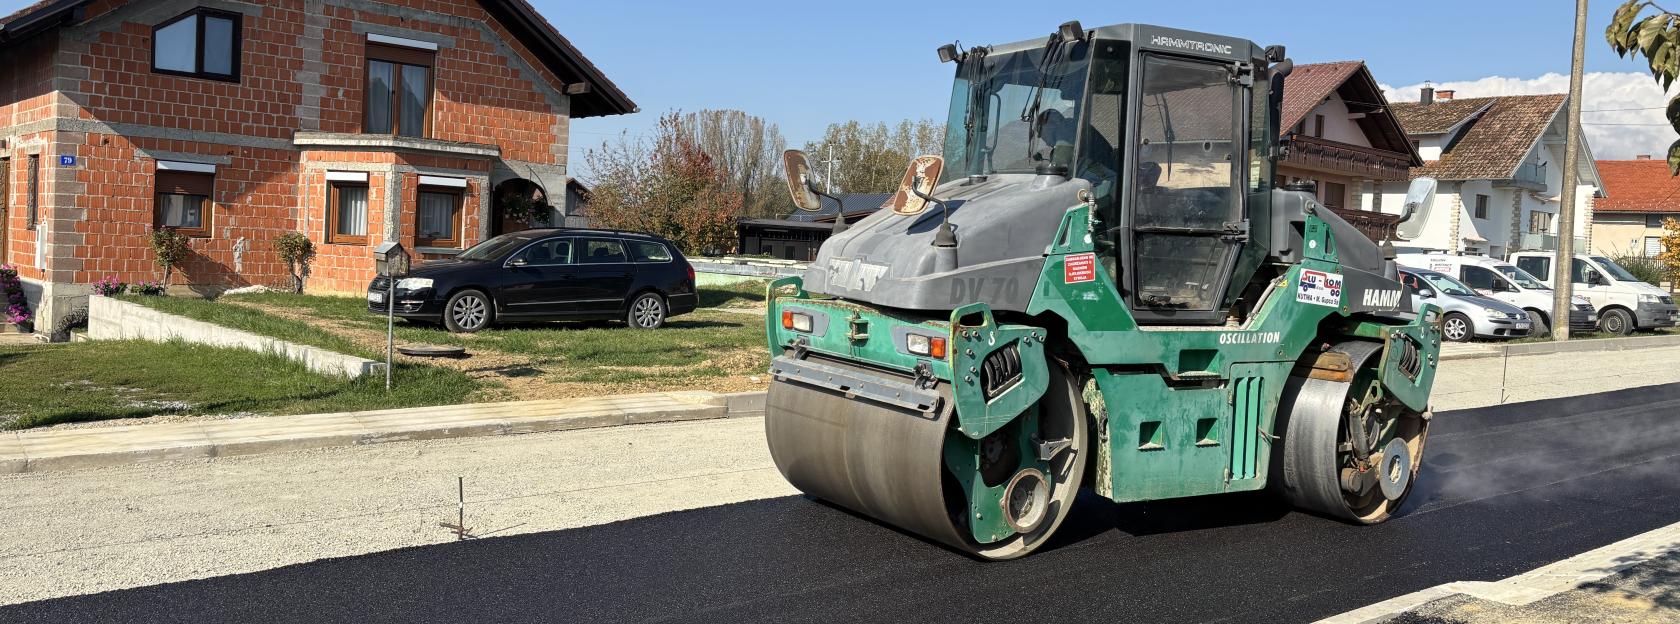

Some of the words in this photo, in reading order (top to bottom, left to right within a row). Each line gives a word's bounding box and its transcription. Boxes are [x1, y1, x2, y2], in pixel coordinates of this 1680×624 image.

[1151, 35, 1232, 54] HAMMTRONIC
[1362, 288, 1400, 307] HAMM
[1219, 331, 1280, 344] OSCILLATION
